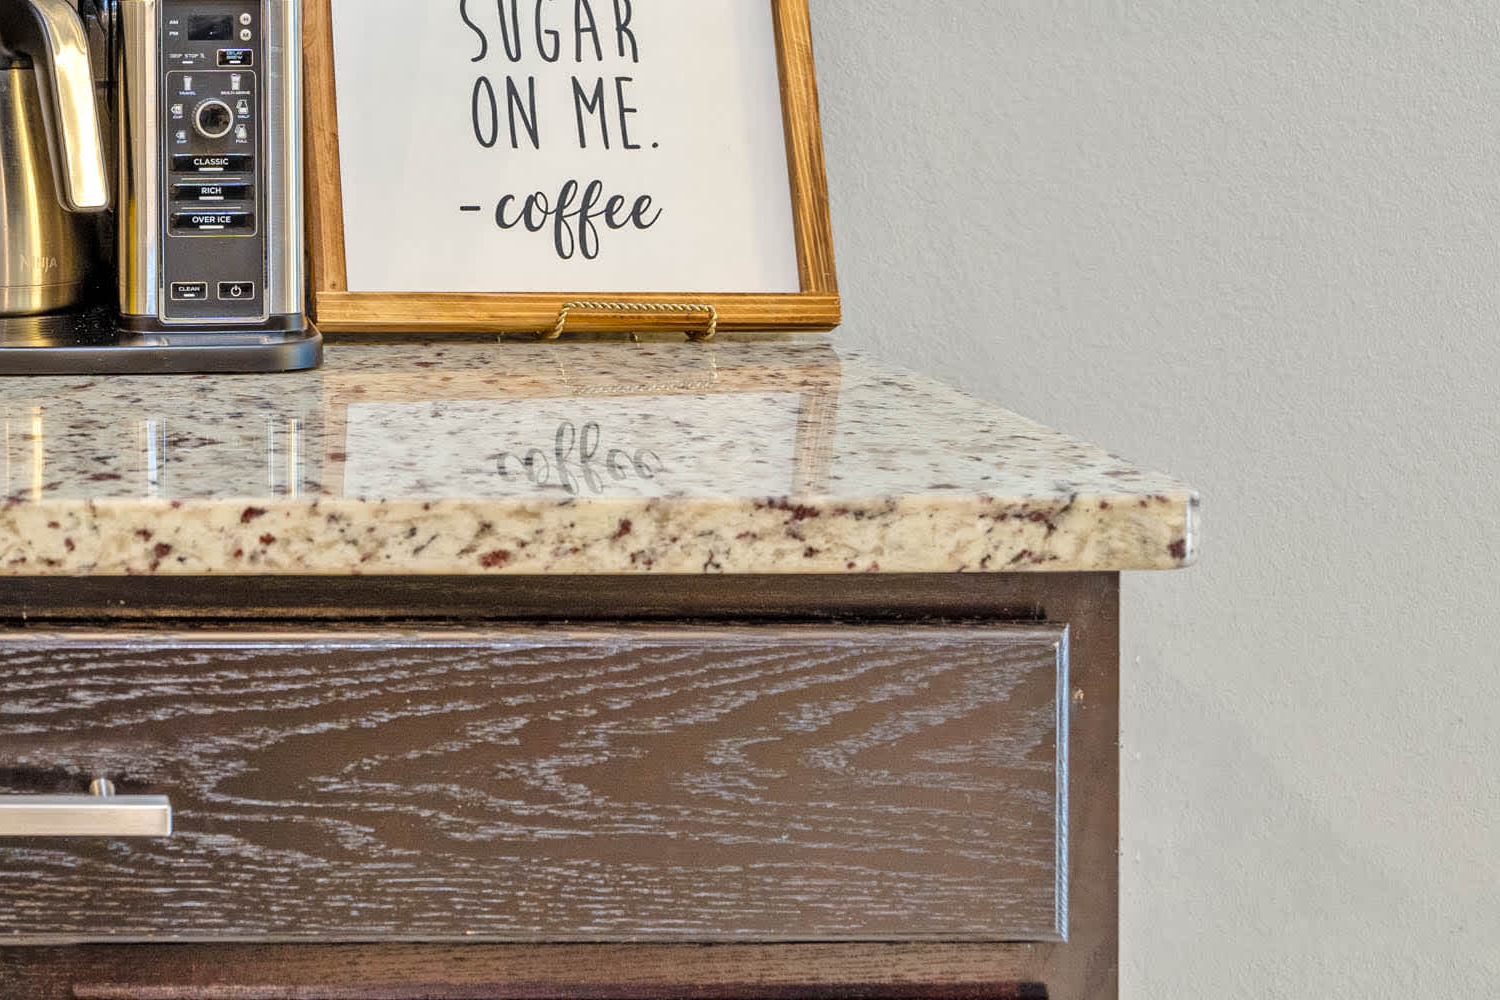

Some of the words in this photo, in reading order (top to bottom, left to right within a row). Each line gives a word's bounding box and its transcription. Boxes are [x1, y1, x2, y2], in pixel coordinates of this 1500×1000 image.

[471, 75, 540, 149] ON
[571, 75, 659, 149] ME.
[193, 158, 229, 166] CLASSIC
[192, 215, 215, 223] OVER
[217, 215, 232, 223] ICE
